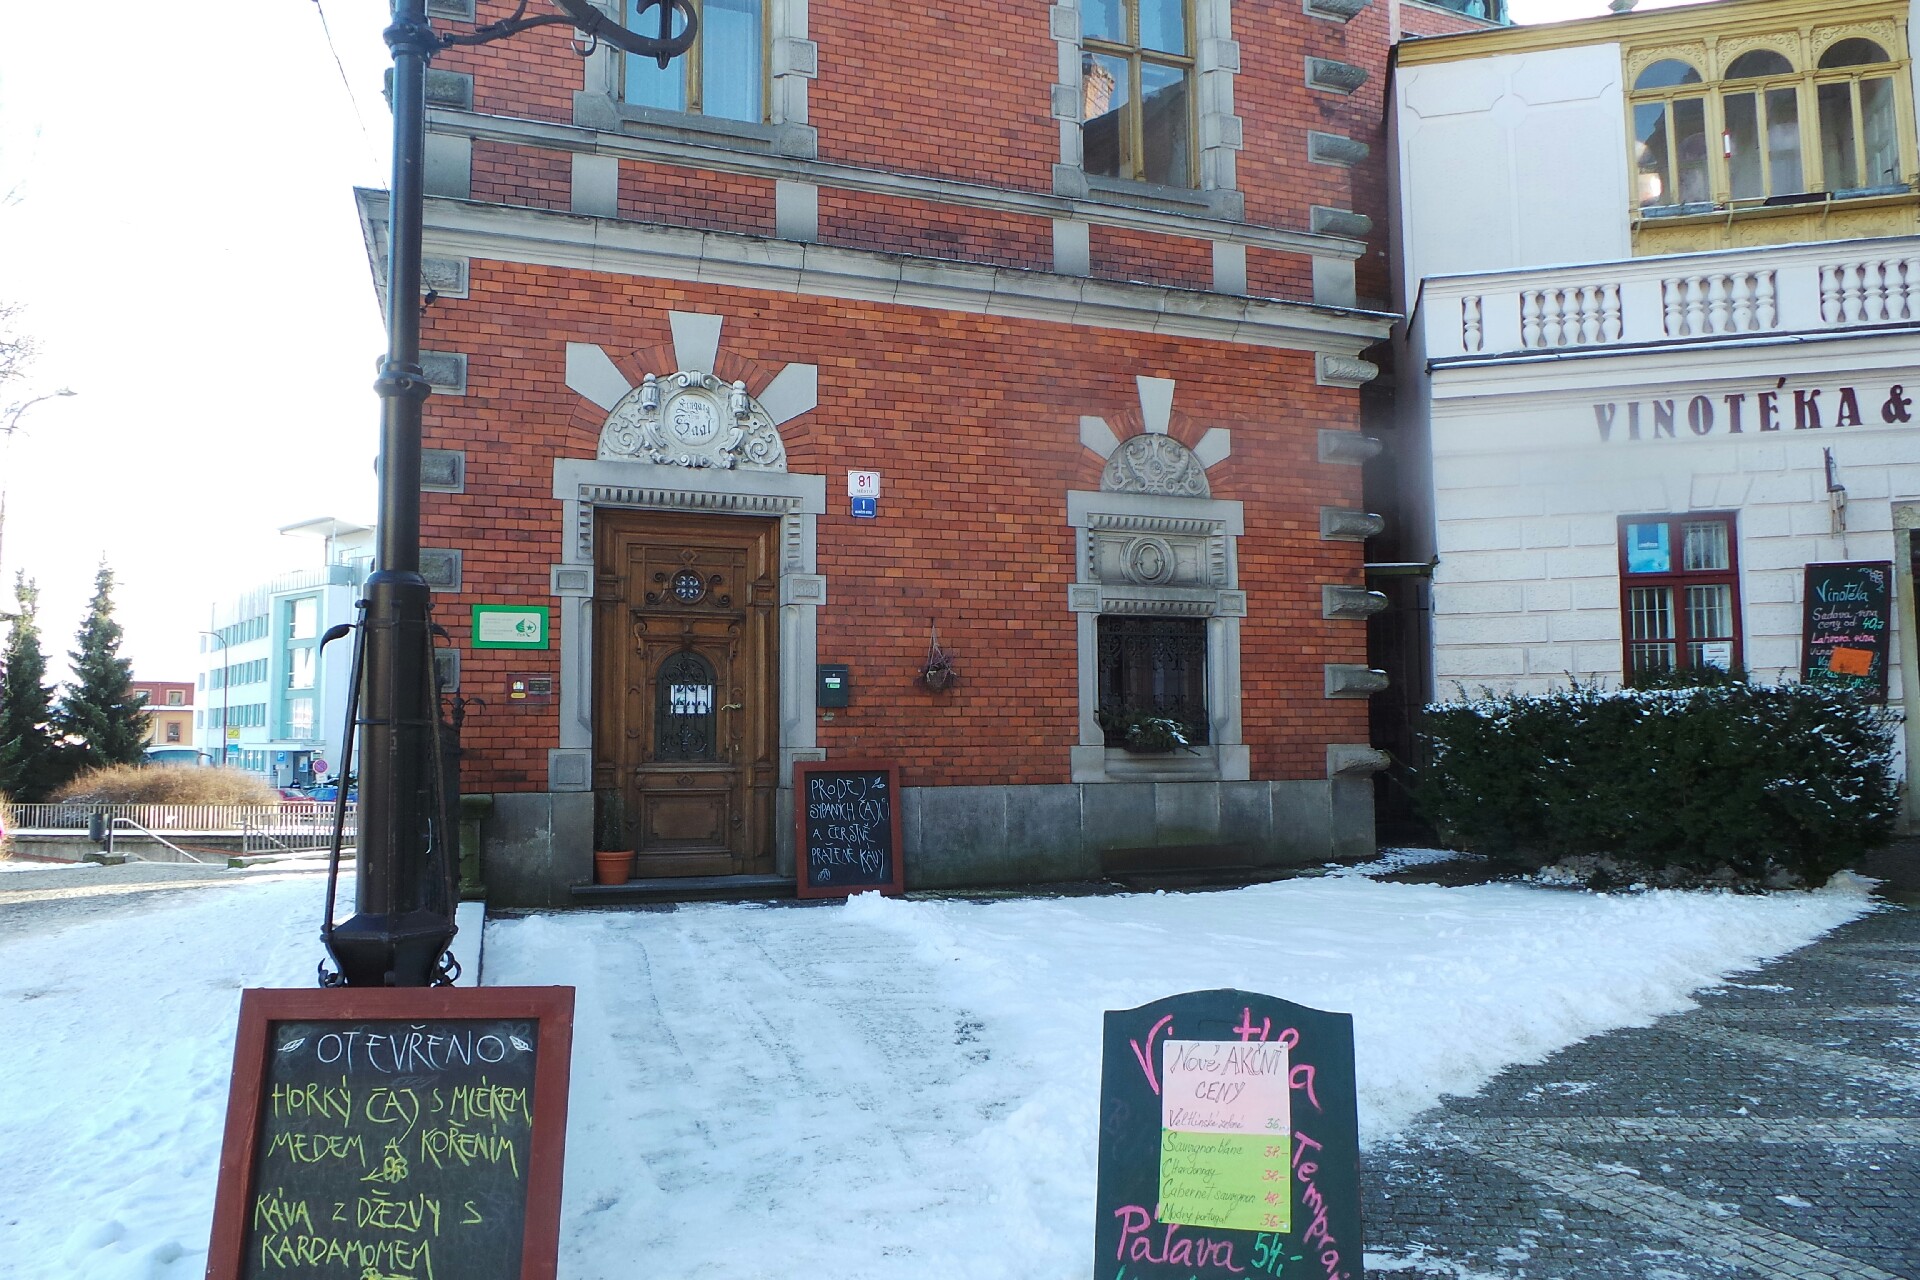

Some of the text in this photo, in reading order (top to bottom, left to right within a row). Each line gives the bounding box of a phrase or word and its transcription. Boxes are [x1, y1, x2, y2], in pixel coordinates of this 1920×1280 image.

[1593, 377, 1913, 442] VINOTÉKA &
[858, 475, 871, 488] 81
[862, 499, 866, 510] 1
[1816, 579, 1869, 602] Vinotéka
[1818, 620, 1841, 631] ceny
[1843, 618, 1857, 627] od
[811, 777, 867, 800] PRODEJ
[810, 798, 890, 827] SYPANÝCH ČAJŮ
[813, 823, 875, 845] A ČERSTVĚ
[811, 843, 884, 878] PRAŽENÉ KÁVY
[317, 1024, 506, 1073] OTEVŘENO
[1170, 1043, 1283, 1076] Nové AKČNÍ
[1195, 1081, 1246, 1104] CENY
[272, 1075, 351, 1128] HORKÝ
[366, 1087, 419, 1143] ČAJ
[267, 1119, 519, 1180] MEDEM A KOŘENÍM
[1163, 1132, 1216, 1163] Sauvignon
[1217, 1138, 1243, 1155] blanc
[1162, 1178, 1217, 1201] Cabernet
[254, 1187, 314, 1235] KÁVA
[358, 1188, 440, 1236] DŽEZVY
[1162, 1203, 1195, 1221] Modrý
[262, 1235, 433, 1280] KARDAMOMEM
[1251, 1232, 1303, 1277] 54,-
